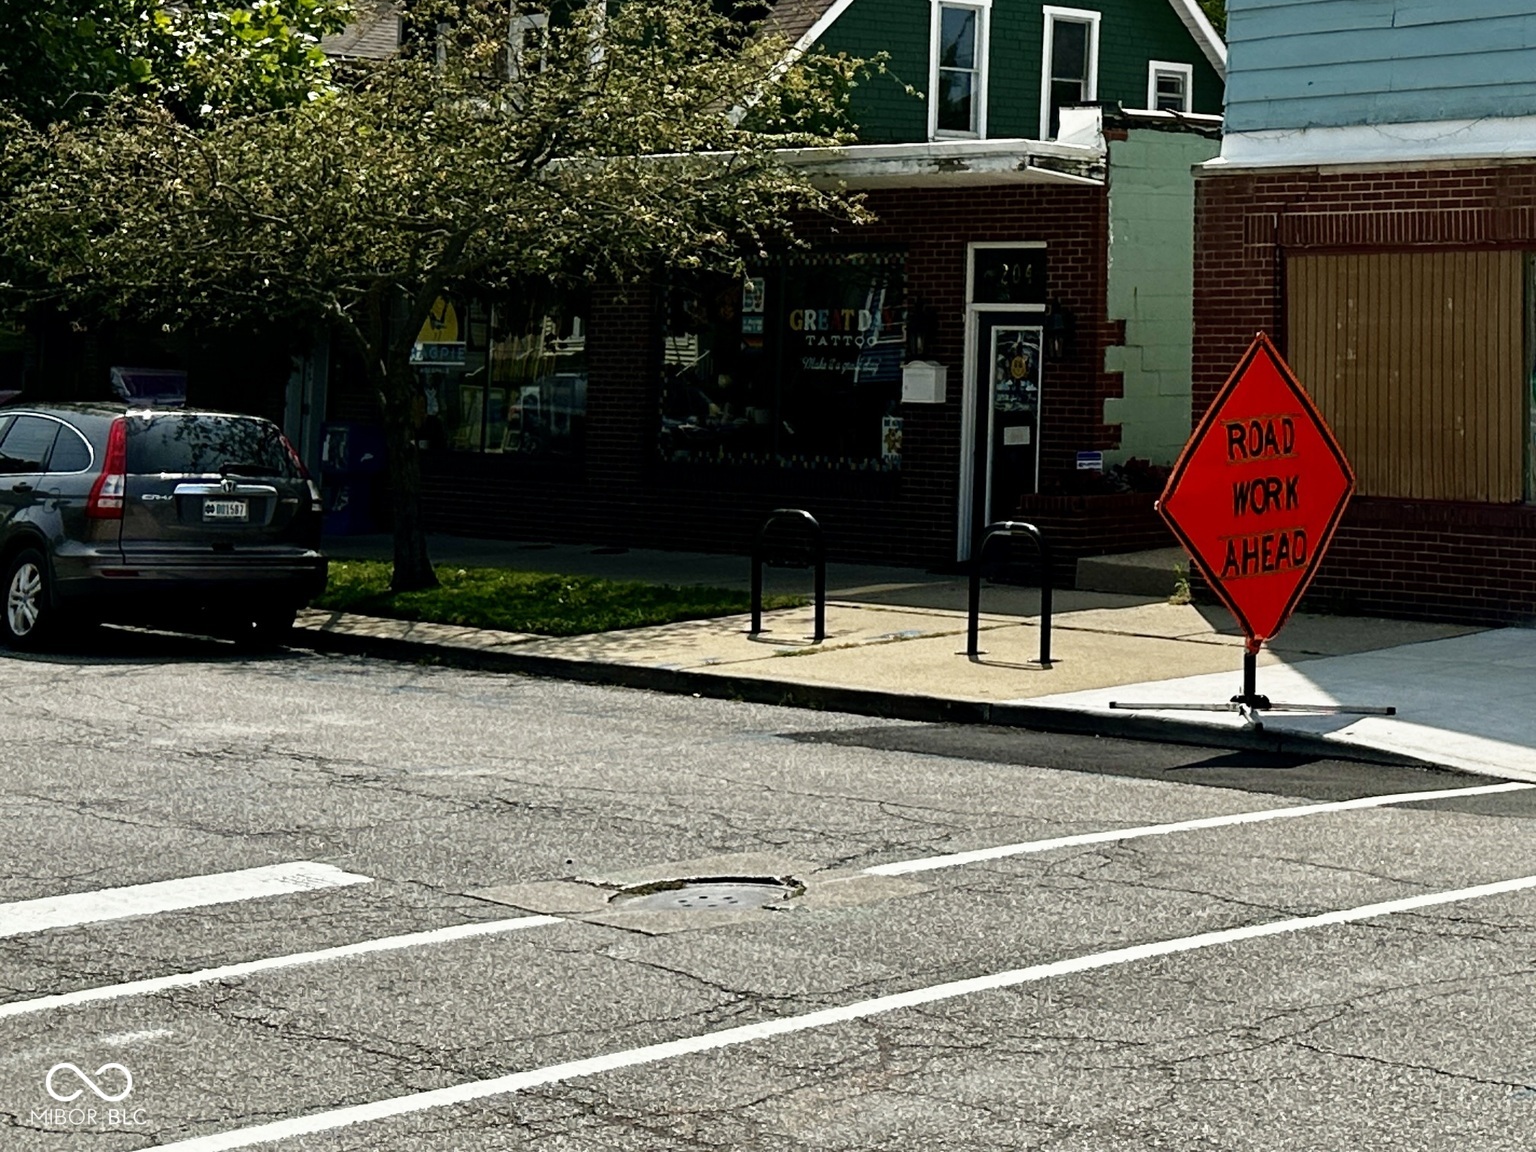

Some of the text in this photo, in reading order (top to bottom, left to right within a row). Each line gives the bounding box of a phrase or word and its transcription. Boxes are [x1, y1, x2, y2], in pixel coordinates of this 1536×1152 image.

[1000, 263, 1033, 285] 204
[789, 308, 855, 332] GREAT
[804, 334, 877, 348] TATTOO
[1225, 417, 1294, 461] ROAD
[1233, 475, 1299, 517] WORK
[1221, 529, 1308, 578] AHEAD
